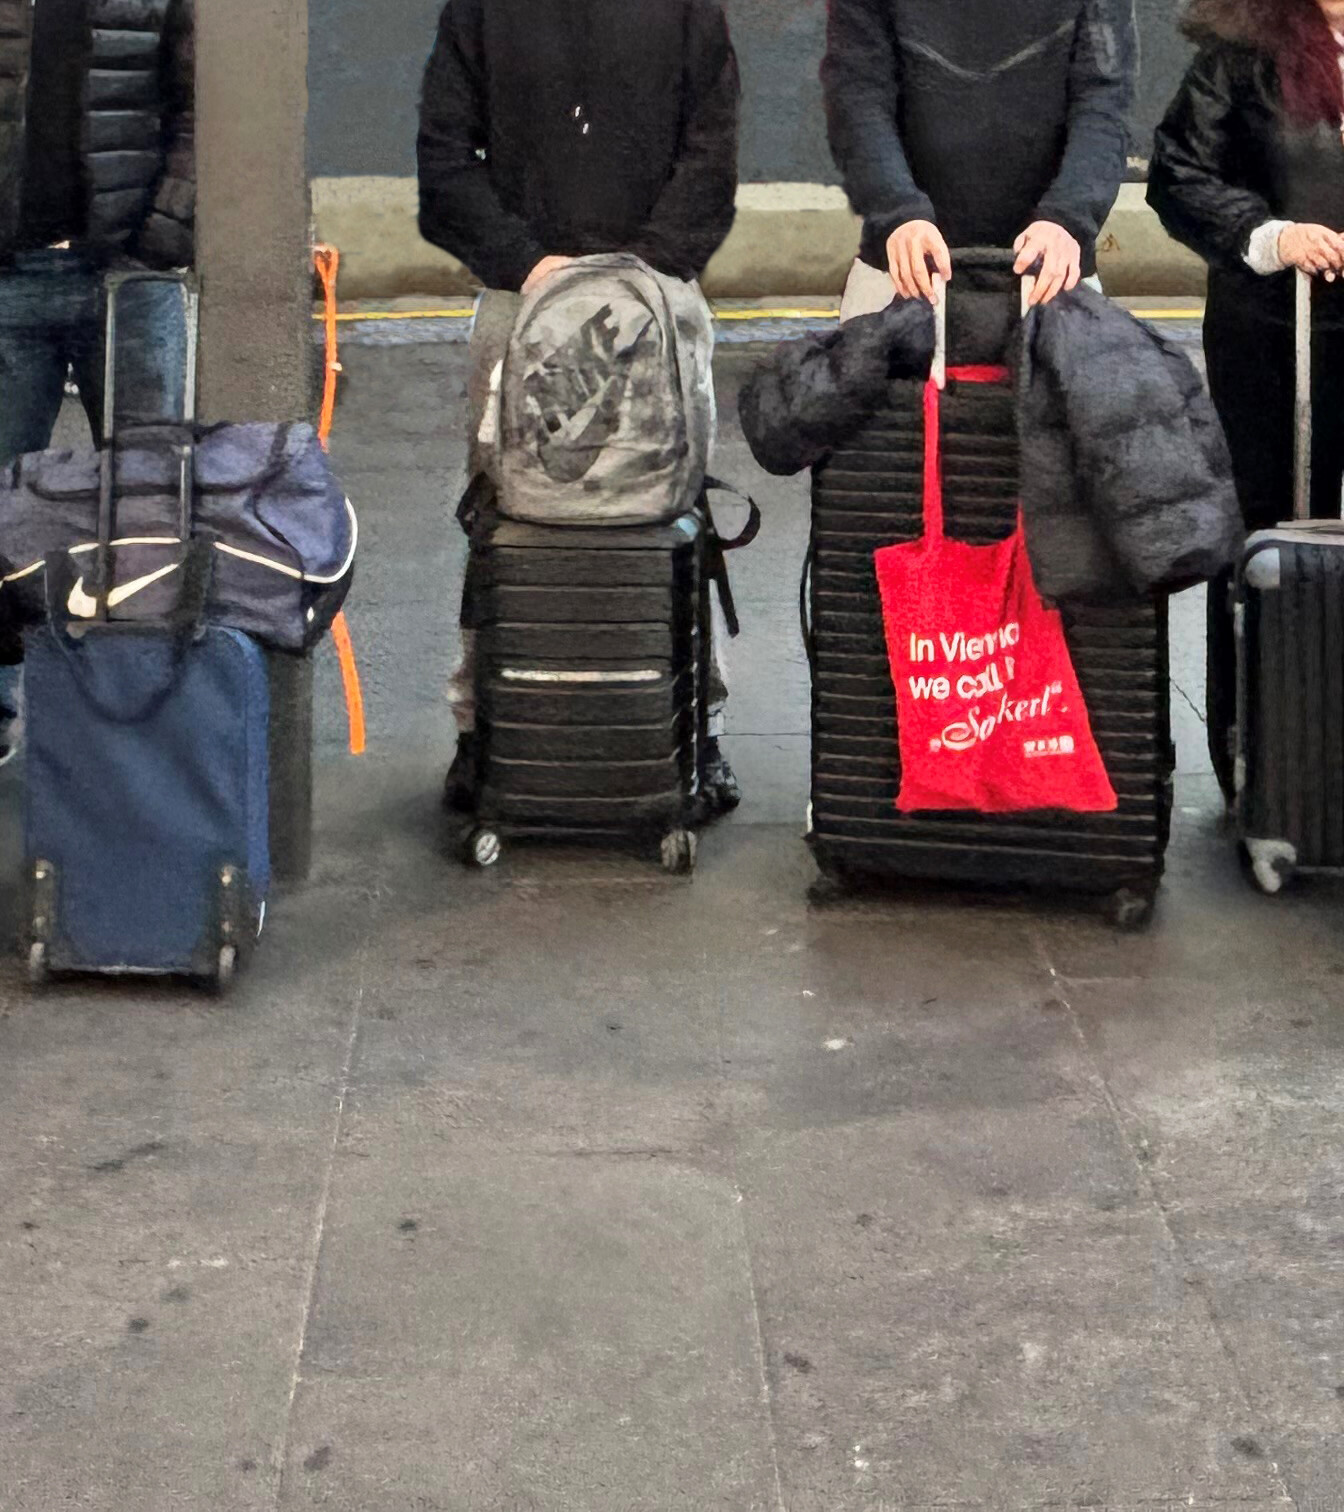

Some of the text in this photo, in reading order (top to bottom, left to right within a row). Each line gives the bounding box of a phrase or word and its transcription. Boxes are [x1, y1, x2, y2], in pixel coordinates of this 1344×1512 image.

[909, 632, 935, 662] In
[908, 675, 951, 701] we
[956, 662, 1004, 700] call
